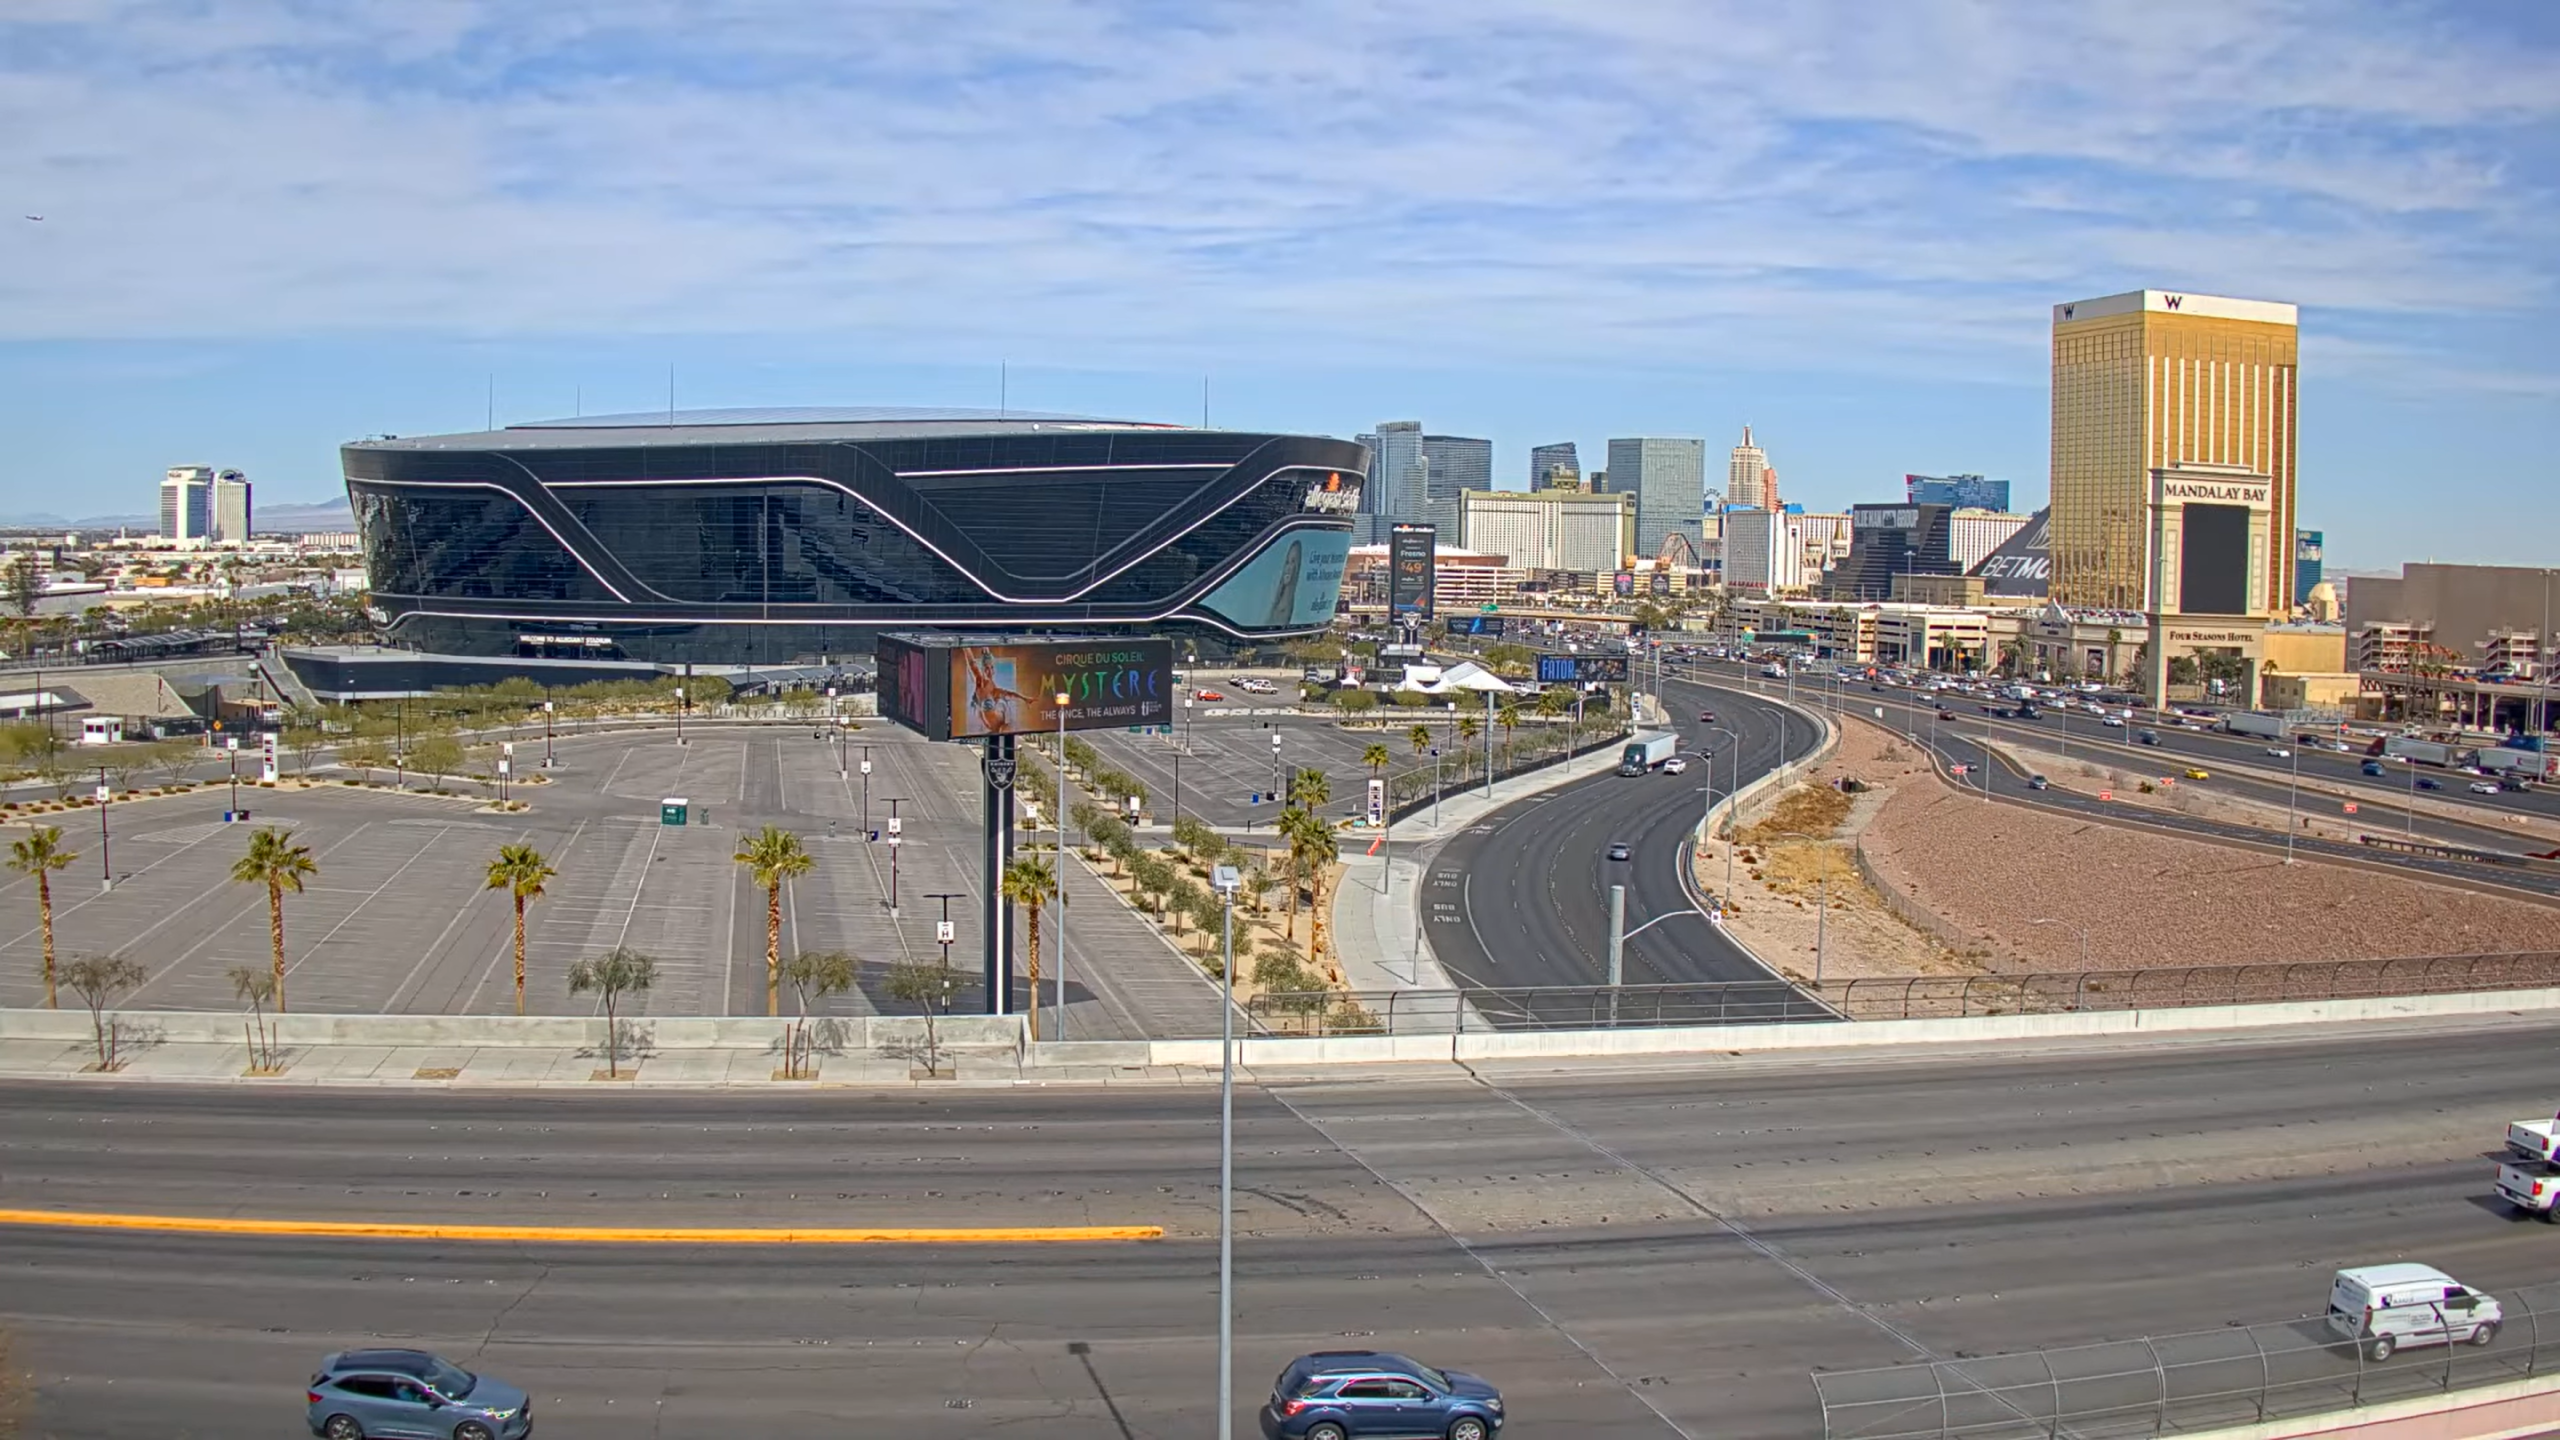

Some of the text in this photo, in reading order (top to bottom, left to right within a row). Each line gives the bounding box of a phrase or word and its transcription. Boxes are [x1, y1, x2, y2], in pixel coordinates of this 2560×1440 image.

[2164, 294, 2182, 310] W
[2063, 304, 2075, 320] W
[2165, 484, 2267, 501] MANDALAY BAY
[1055, 651, 1144, 667] CIRQUE DU SOLEIL
[1542, 660, 1575, 679] FATOR
[1040, 665, 1158, 701] MYSTÈRE
[1040, 710, 1057, 720] THE
[1086, 706, 1101, 717] THE
[1103, 704, 1136, 716] ALWAYS
[1433, 915, 1461, 923] ONLY
[942, 930, 949, 938] H
